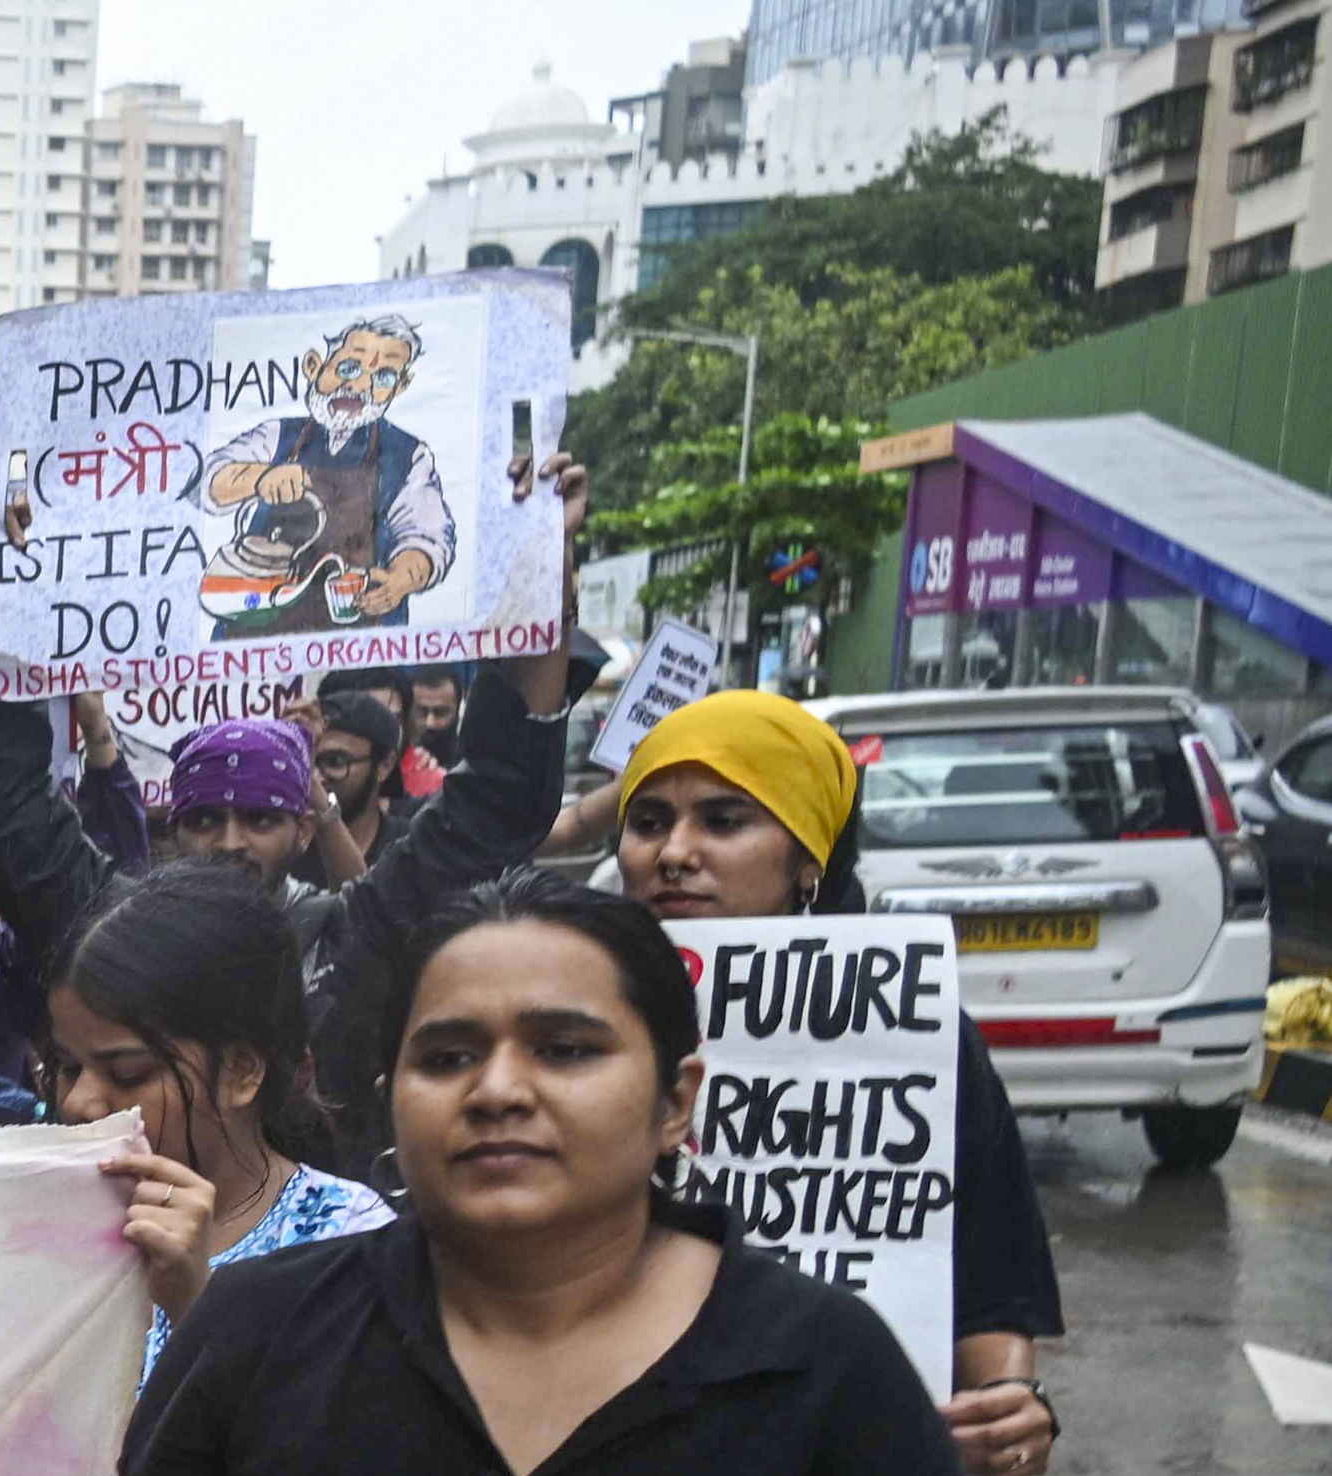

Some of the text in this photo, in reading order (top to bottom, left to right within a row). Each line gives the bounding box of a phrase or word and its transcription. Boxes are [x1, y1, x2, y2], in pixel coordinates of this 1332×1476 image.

[39, 356, 300, 421] PRADHAN
[51, 598, 171, 660] DO!
[307, 620, 555, 667] ORGANISATION
[117, 674, 303, 726] SOCIALISM
[707, 938, 944, 1040] FUTURE
[702, 1074, 937, 1164] RIGHTS
